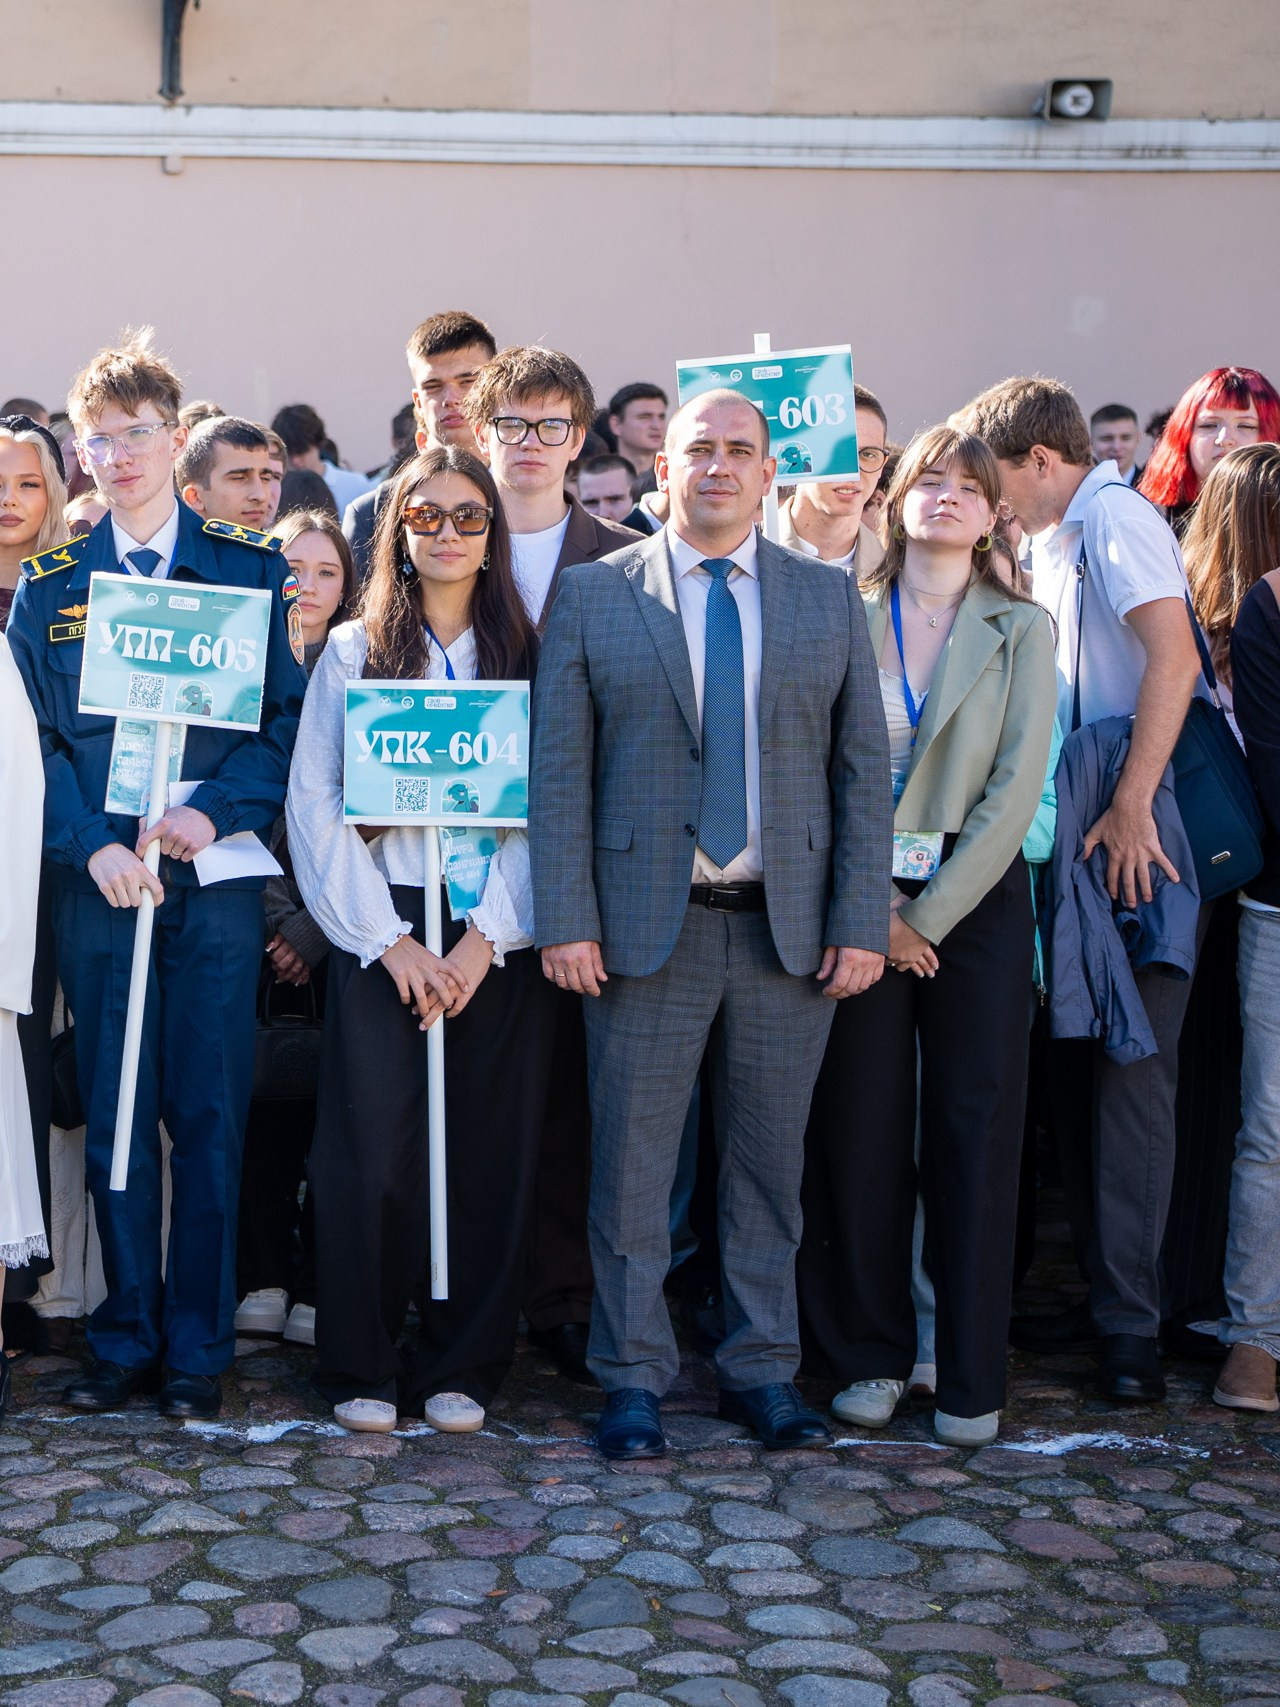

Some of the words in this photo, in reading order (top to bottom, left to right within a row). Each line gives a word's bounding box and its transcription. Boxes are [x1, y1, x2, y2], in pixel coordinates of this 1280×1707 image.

[751, 393, 846, 429] -603
[97, 622, 257, 673] УПП-605
[353, 731, 521, 765] УПК-604
